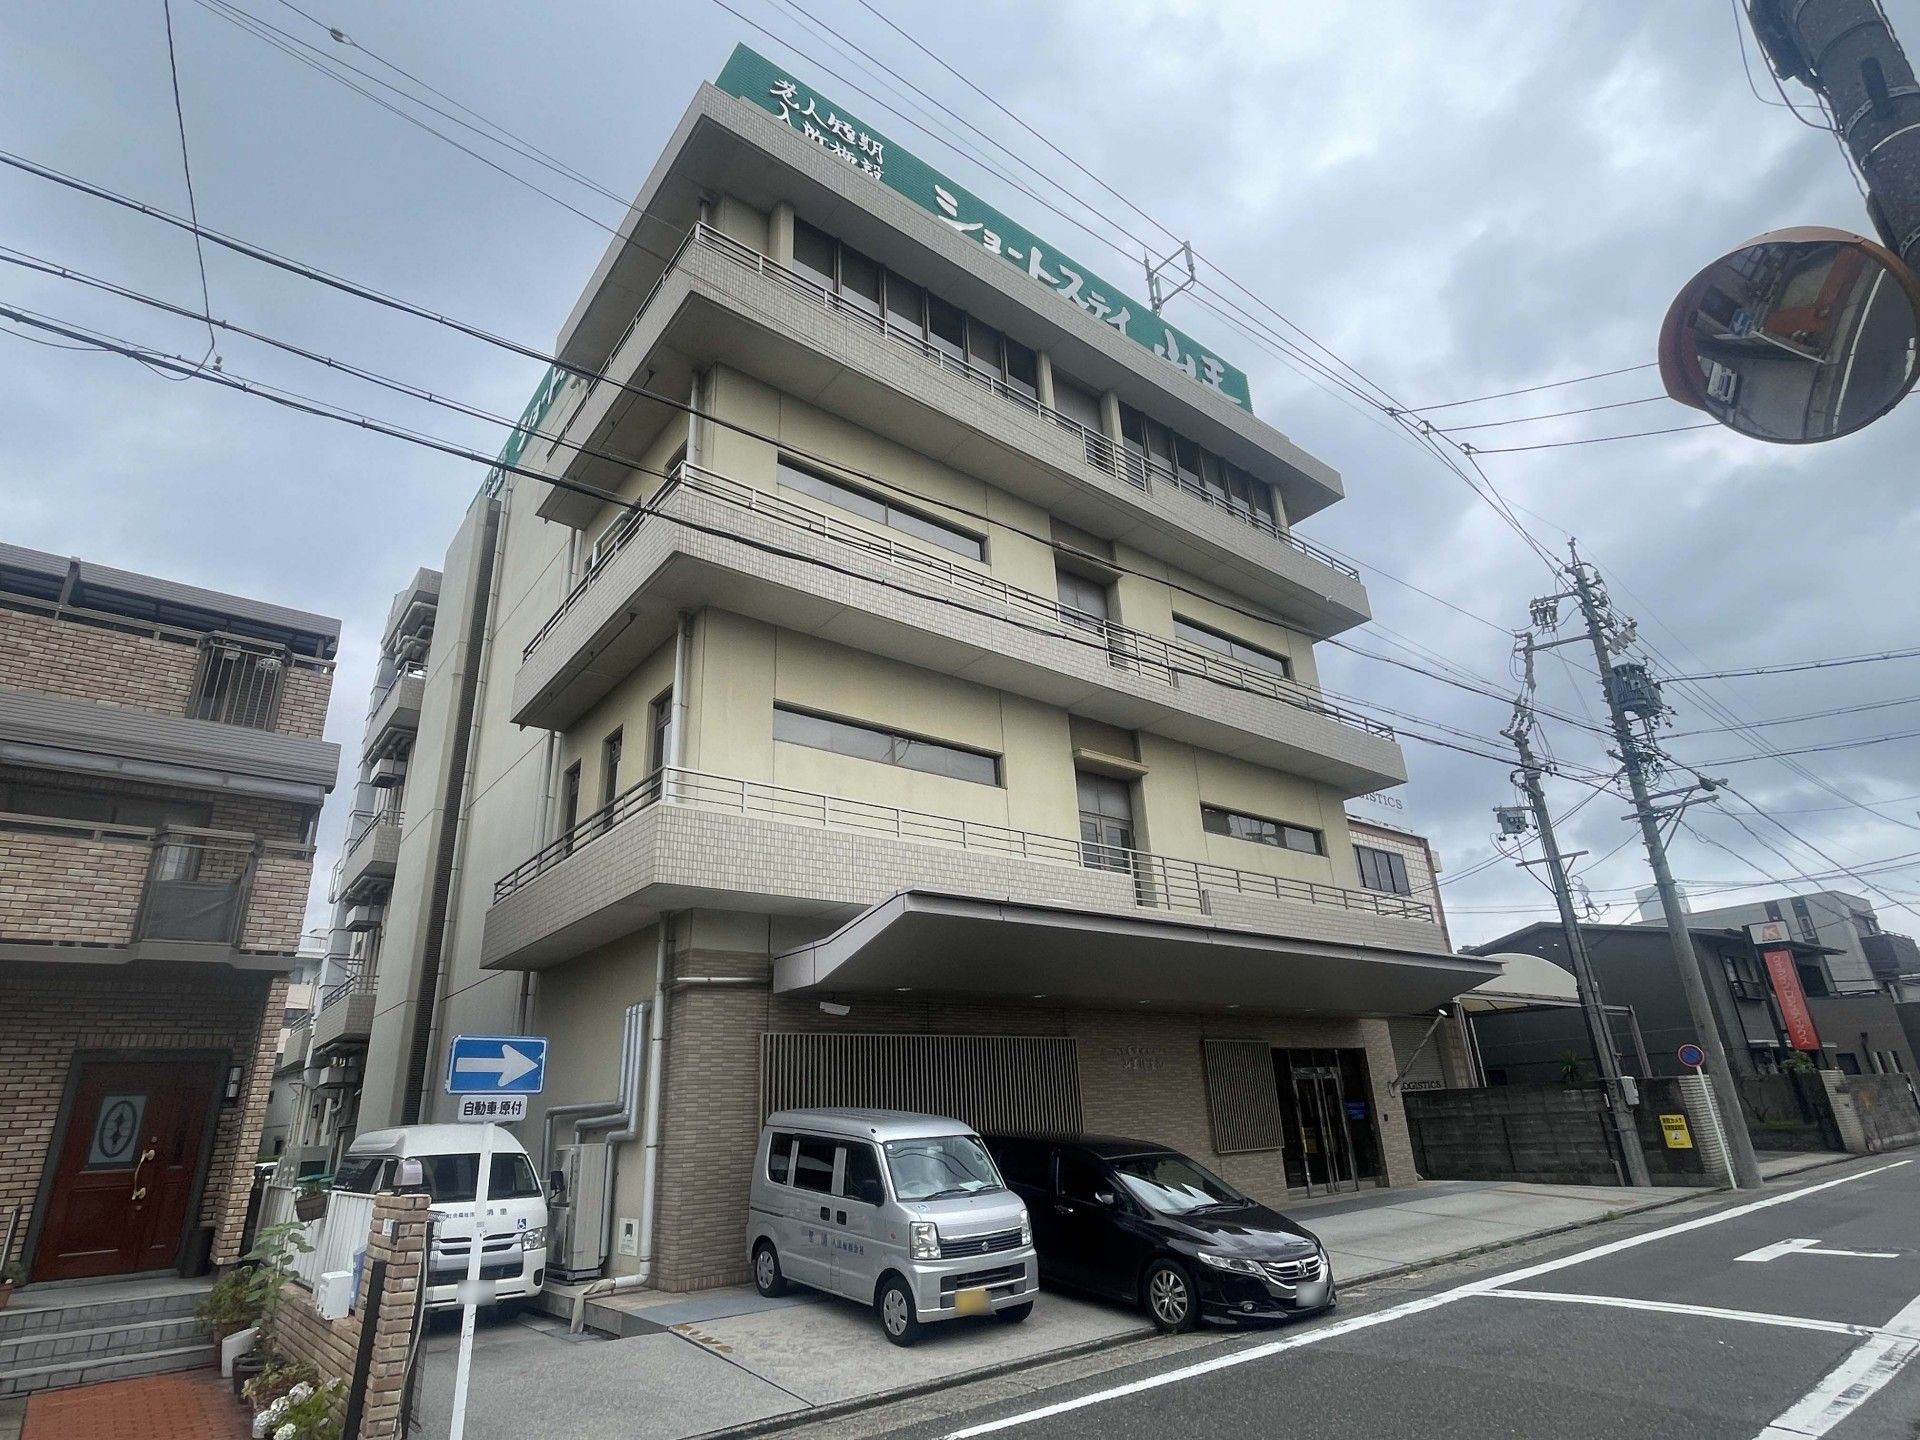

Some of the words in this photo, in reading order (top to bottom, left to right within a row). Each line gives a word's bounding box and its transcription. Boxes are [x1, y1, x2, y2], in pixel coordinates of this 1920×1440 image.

[769, 79, 884, 165] 老人短期
[934, 184, 1151, 336] ショートステイ
[1153, 328, 1242, 405] 山王
[463, 1100, 522, 1116] 自動車・原付
